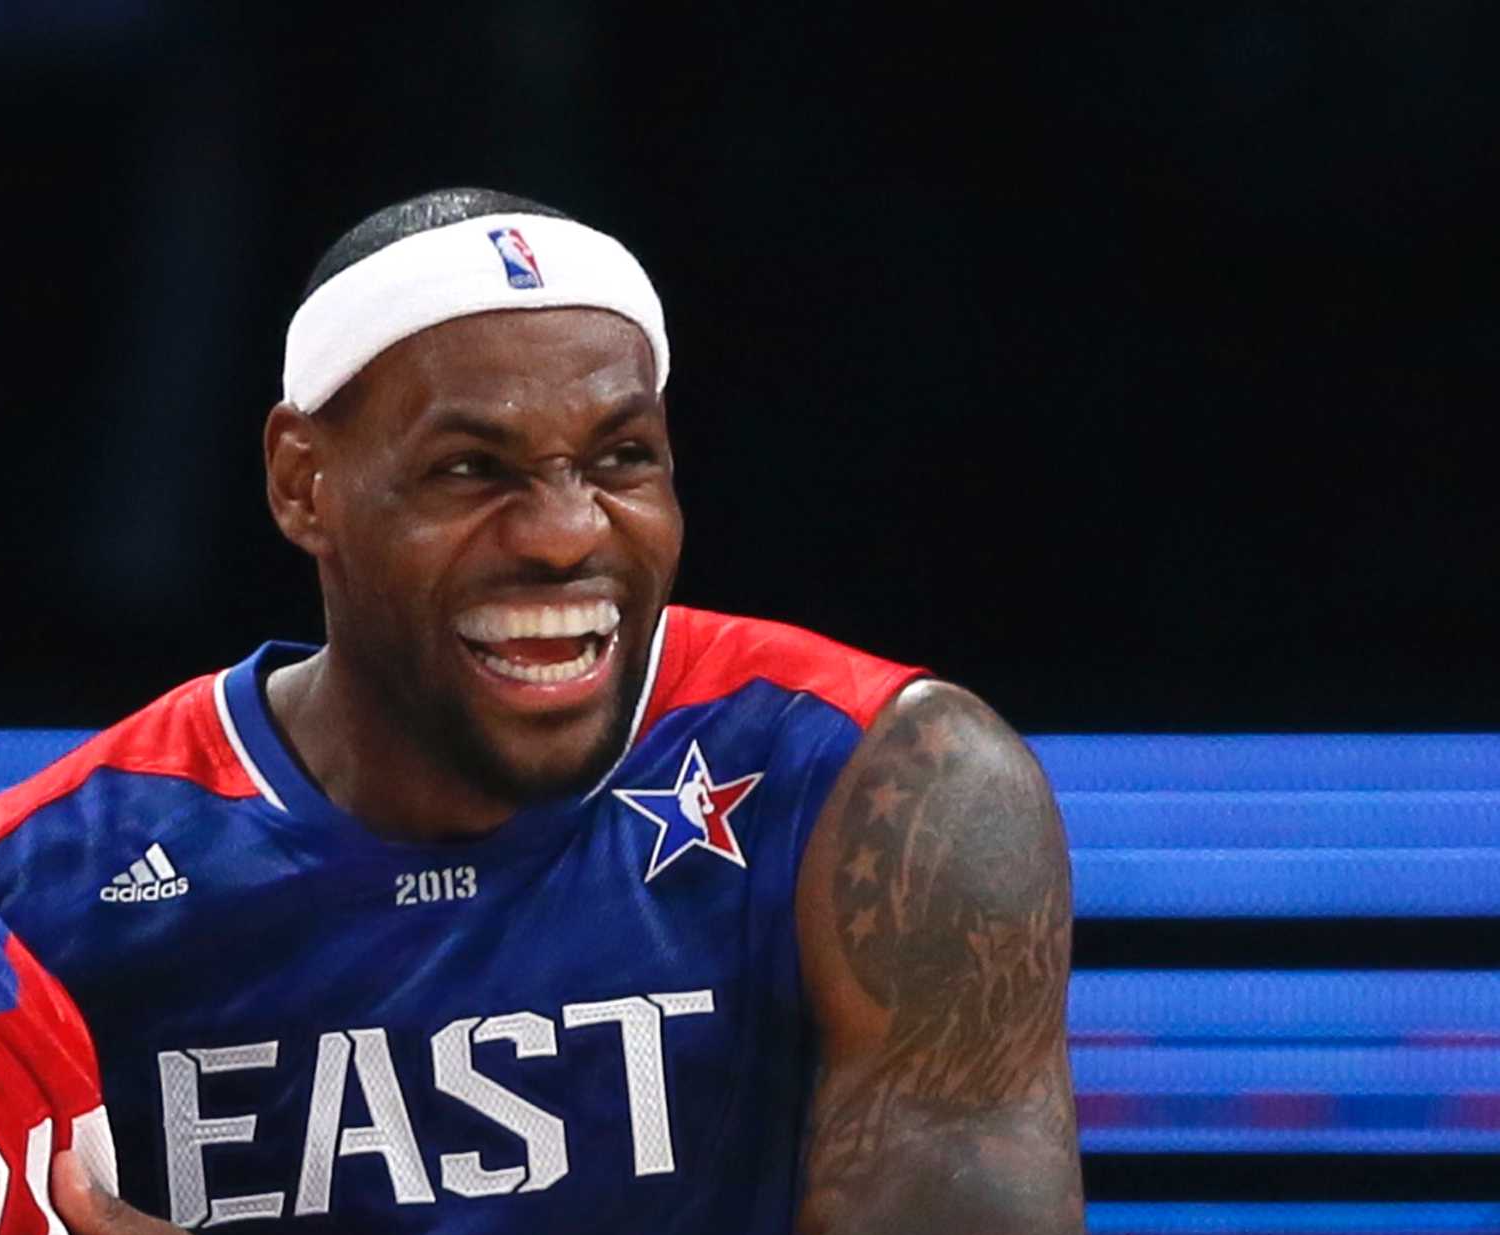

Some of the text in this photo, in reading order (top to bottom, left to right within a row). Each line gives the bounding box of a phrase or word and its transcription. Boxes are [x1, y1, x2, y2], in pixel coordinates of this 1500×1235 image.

[100, 875, 189, 902] adidas
[395, 865, 478, 906] 2013
[157, 989, 715, 1229] EAST
